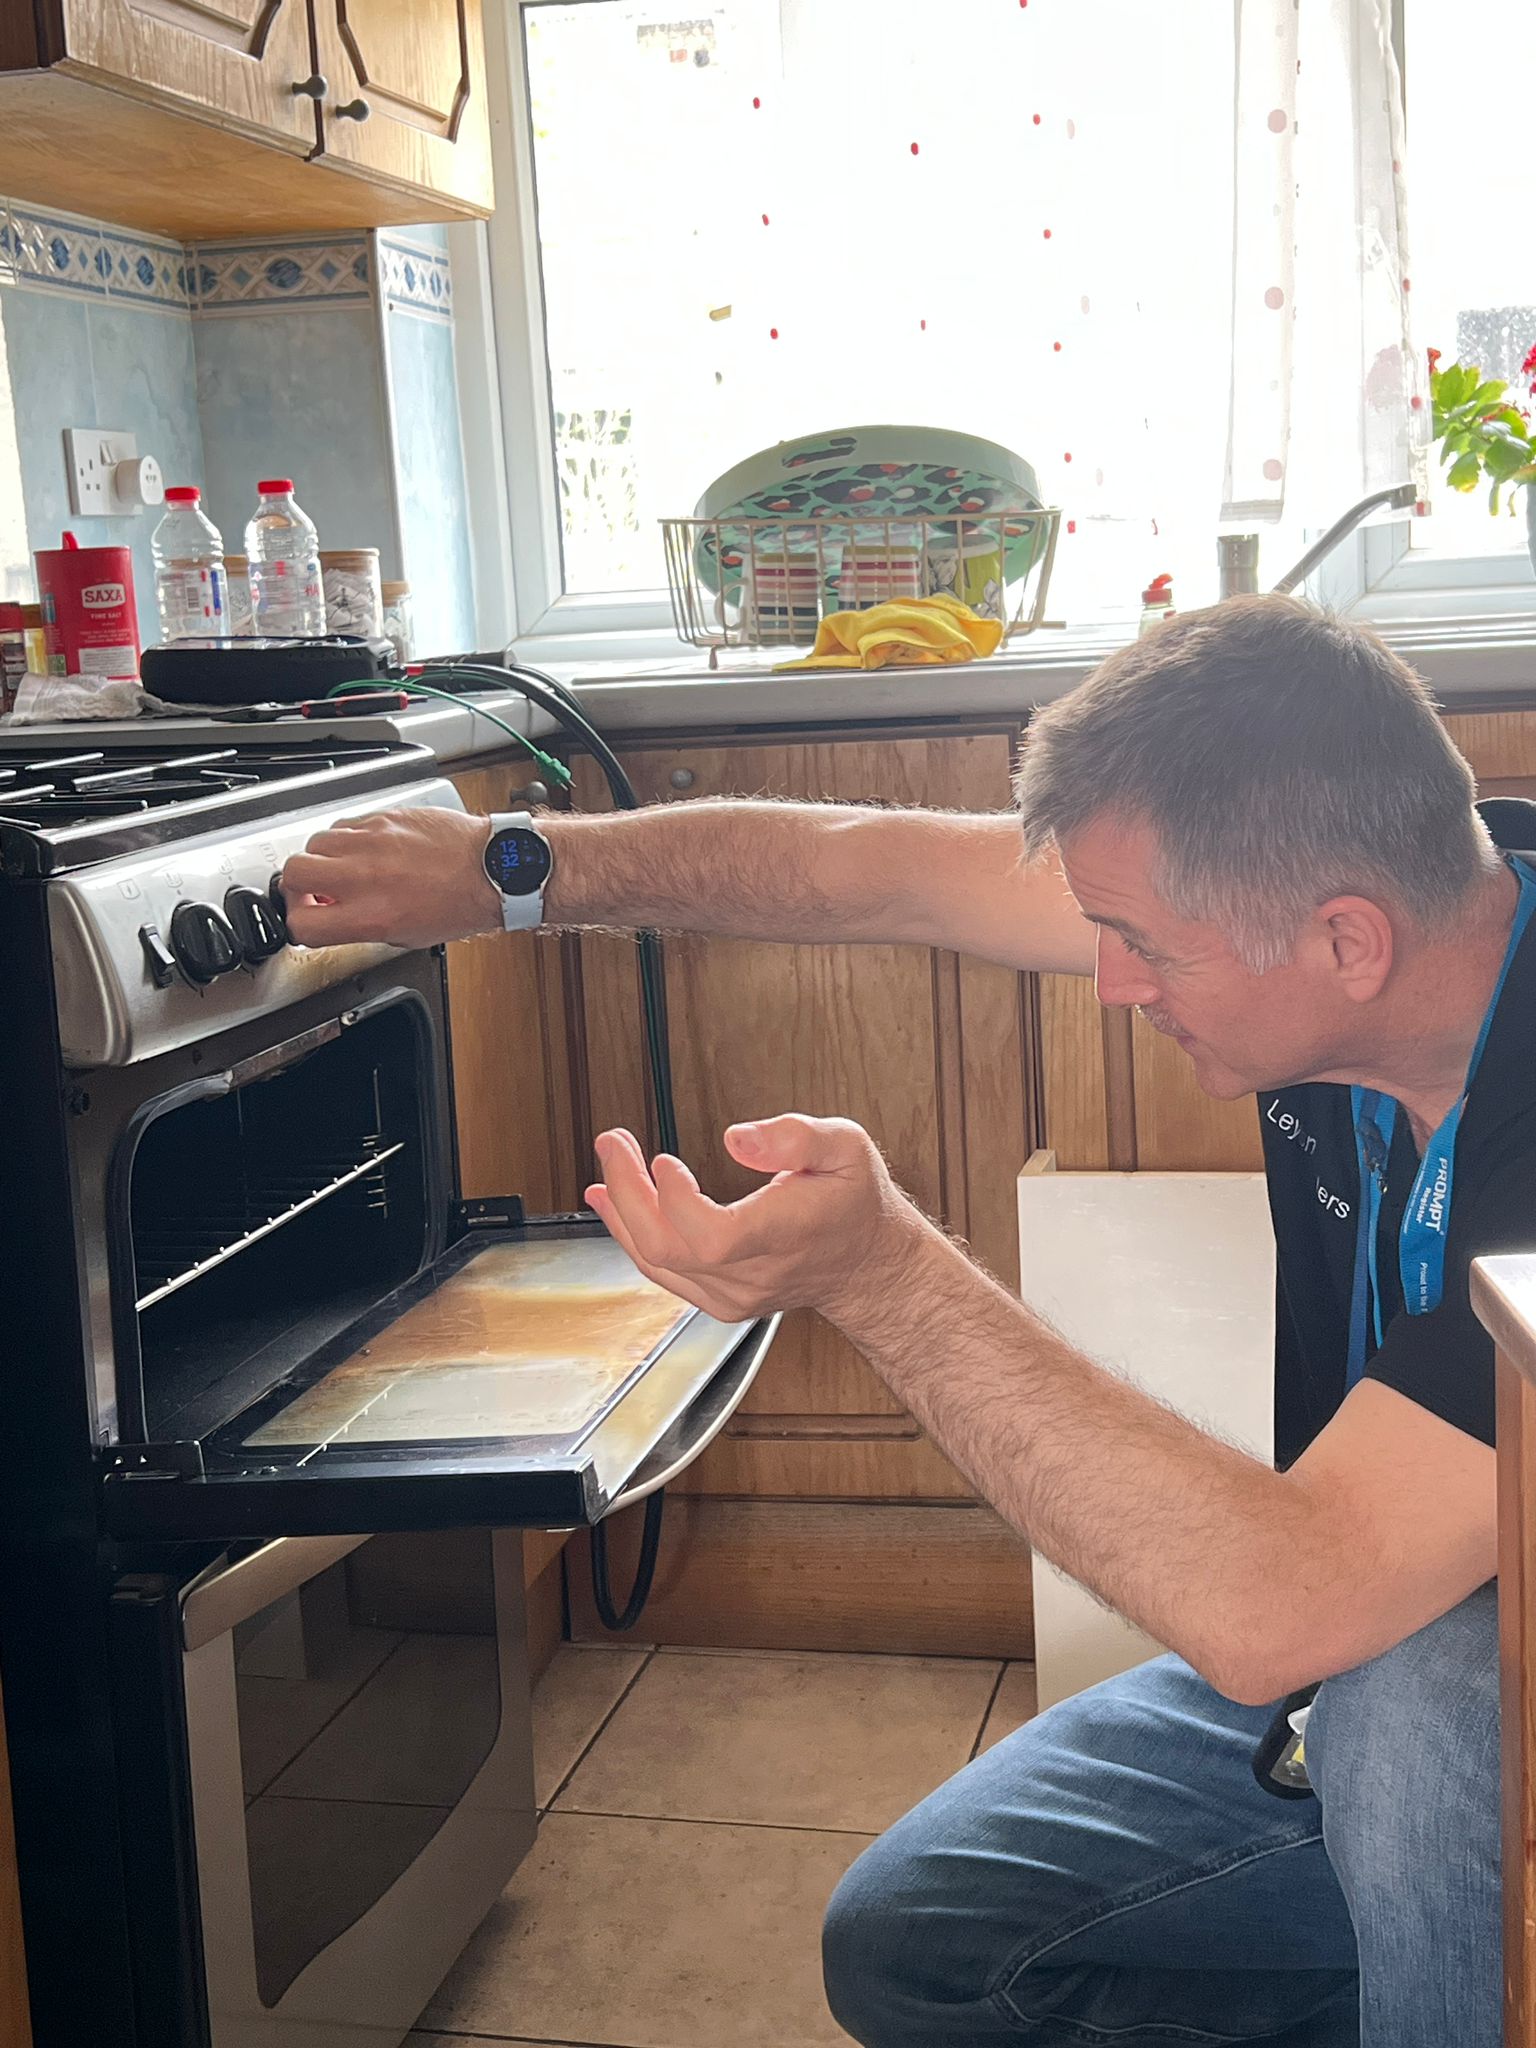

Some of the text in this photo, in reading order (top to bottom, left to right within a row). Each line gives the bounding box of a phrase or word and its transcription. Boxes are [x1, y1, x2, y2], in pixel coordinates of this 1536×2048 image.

[84, 589, 123, 603] SAXA
[500, 840, 518, 853] 12
[501, 854, 520, 868] 32
[1267, 1099, 1350, 1219] Leyn ers
[1425, 1157, 1448, 1232] PROMPT
[1416, 1187, 1431, 1223] Register
[1420, 1262, 1428, 1284] Proud
[1420, 1286, 1428, 1295] to
